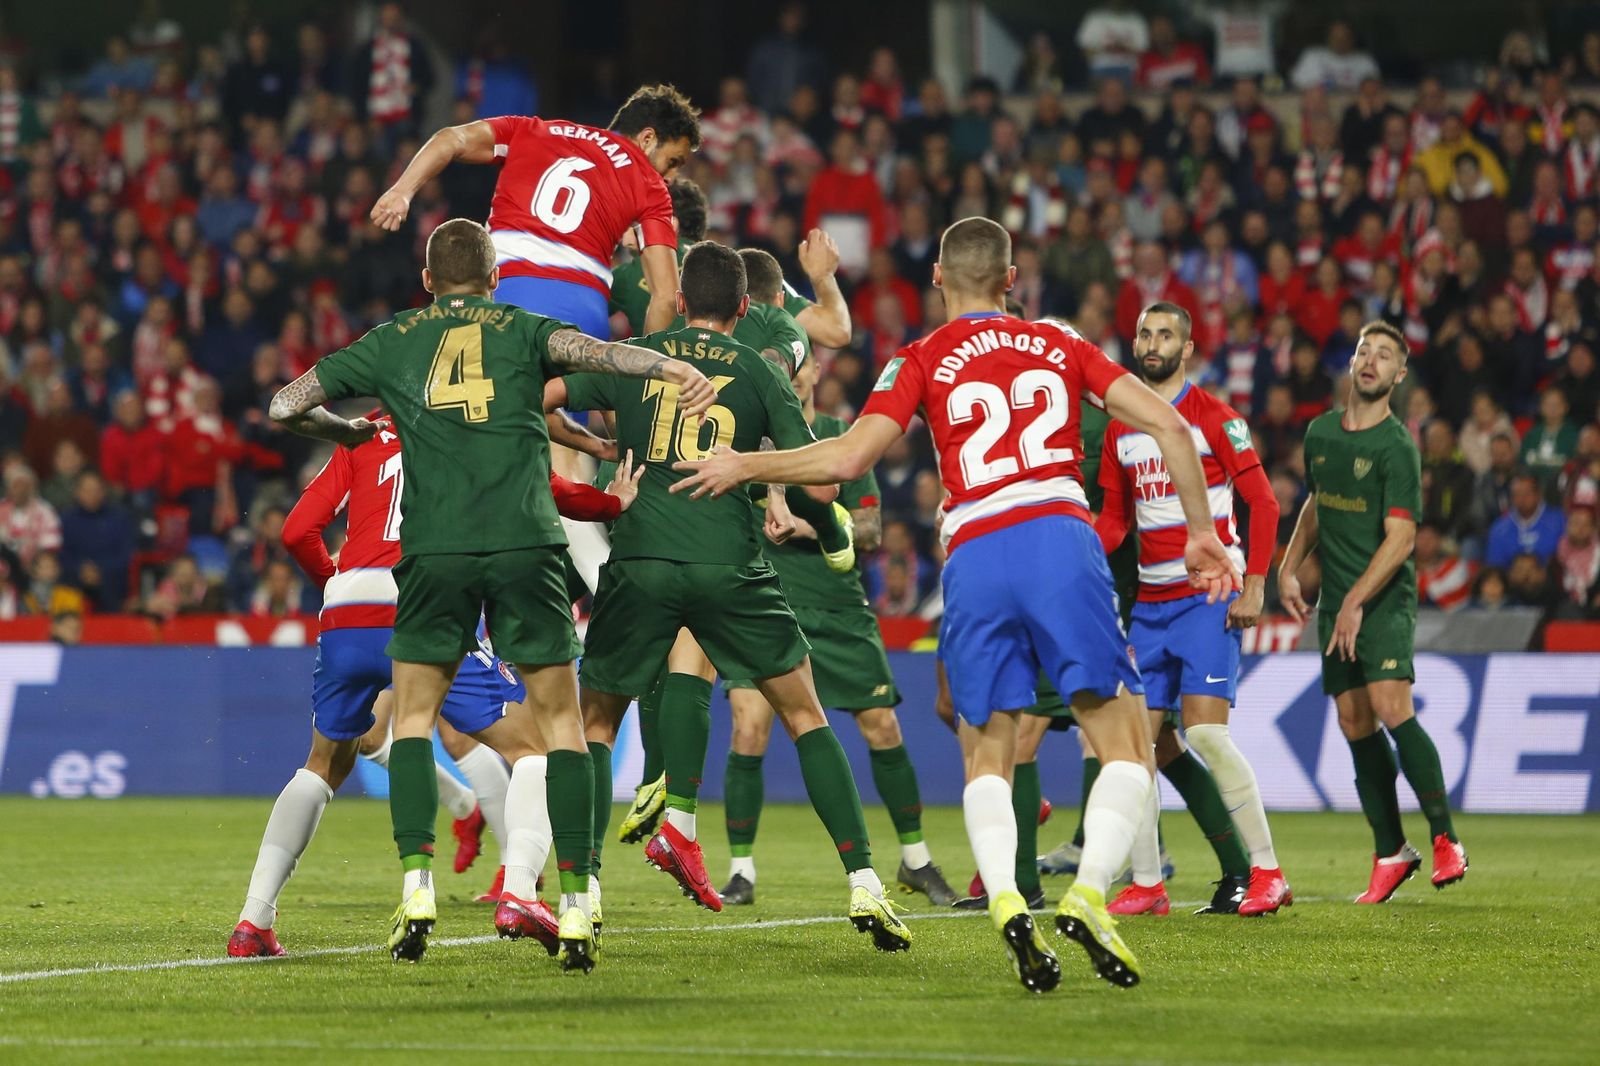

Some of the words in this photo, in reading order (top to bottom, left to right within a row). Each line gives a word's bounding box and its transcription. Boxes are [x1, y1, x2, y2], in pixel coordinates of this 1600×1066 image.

[549, 125, 632, 169] GERMAN
[531, 156, 597, 234] 6
[424, 320, 496, 424] 4
[662, 339, 739, 366] VESGA
[933, 329, 1047, 385] DOMINGOS
[1046, 347, 1067, 371] D.
[641, 374, 736, 463] 16
[946, 368, 1075, 491] 22
[30, 750, 128, 798] .es
